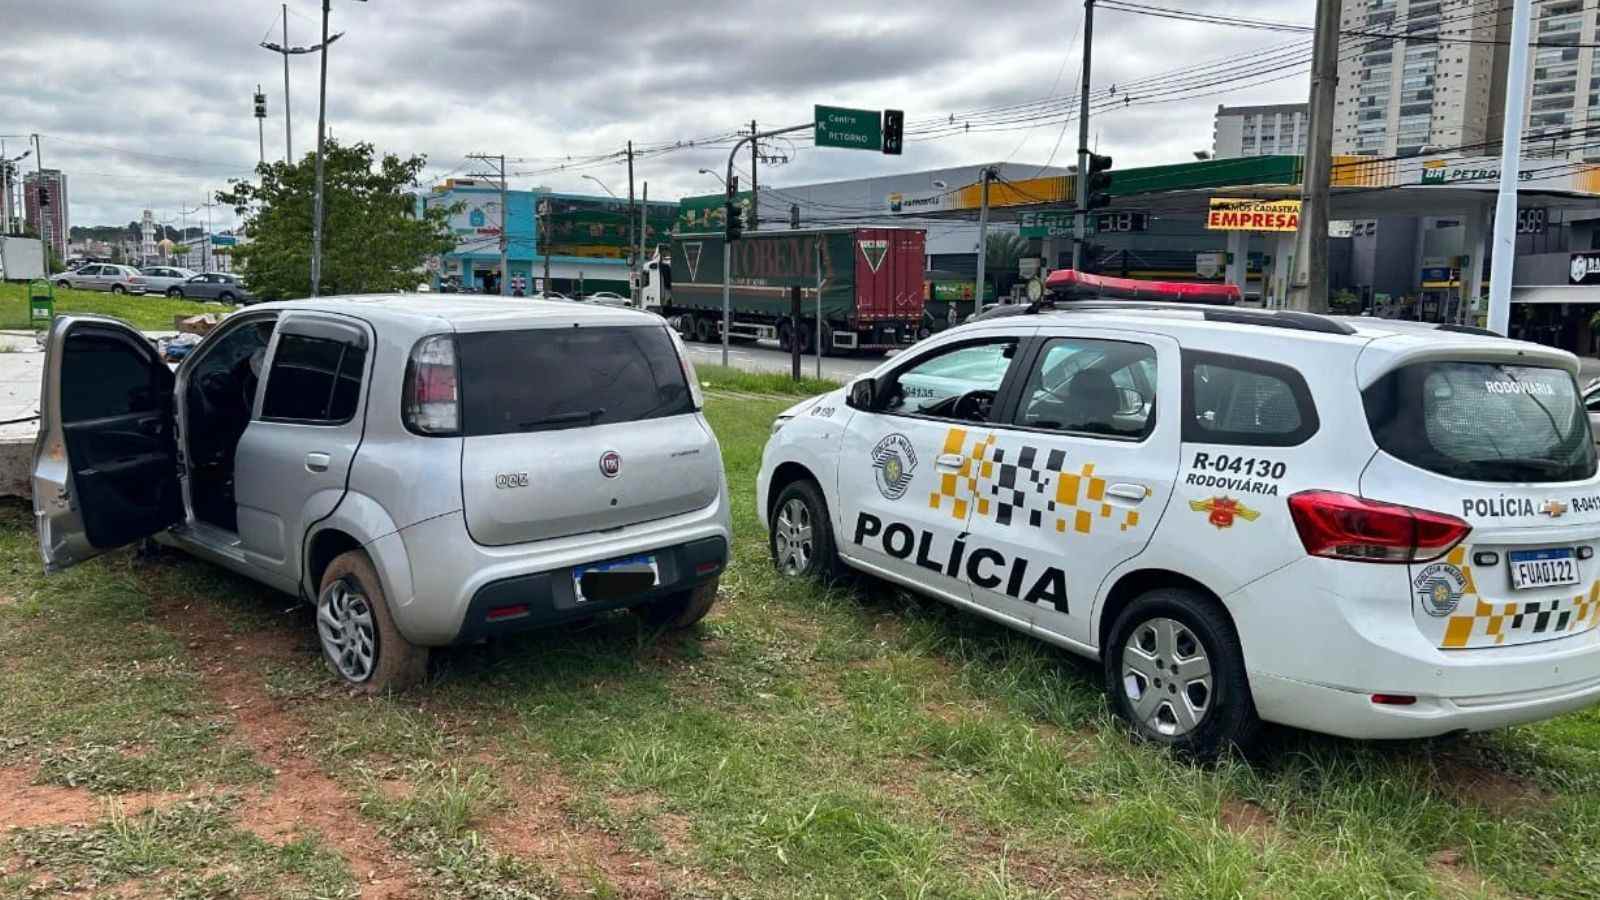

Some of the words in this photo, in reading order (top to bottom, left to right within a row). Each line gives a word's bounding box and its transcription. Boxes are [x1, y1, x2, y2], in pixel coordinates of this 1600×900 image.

[828, 130, 869, 144] RETORNO
[1192, 452, 1286, 479] R-04130
[1186, 473, 1278, 496] RODOVIÁRIA
[1462, 493, 1535, 517] POLÍCIA
[854, 512, 1069, 614] POLÍCIA
